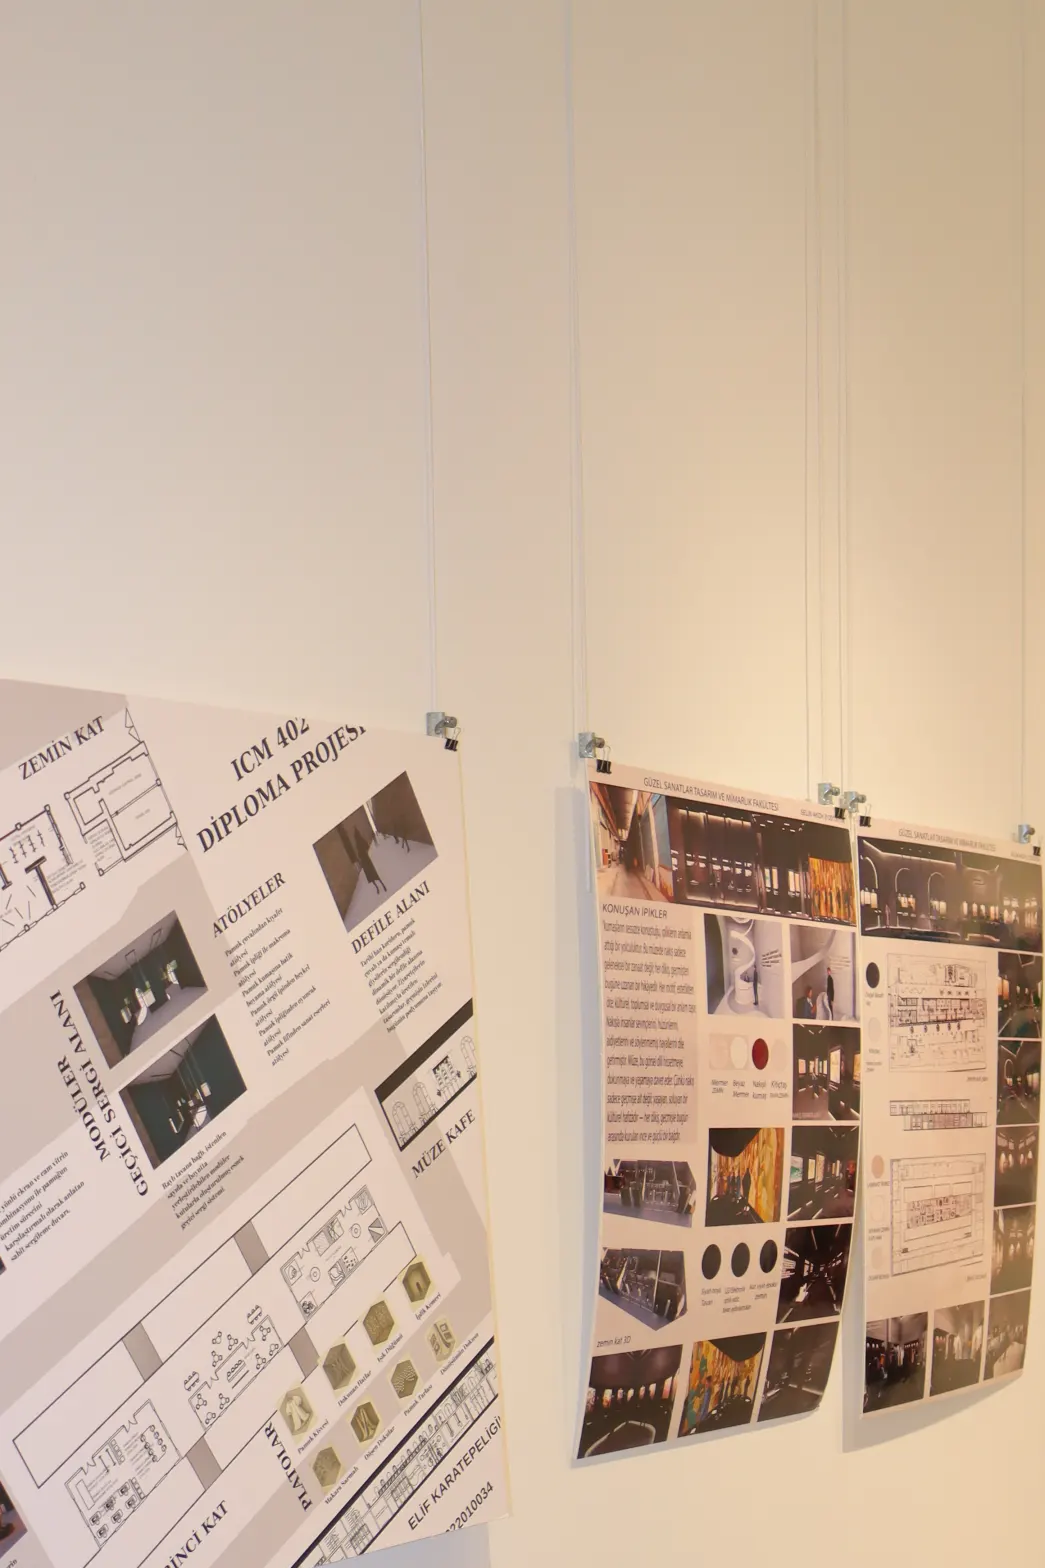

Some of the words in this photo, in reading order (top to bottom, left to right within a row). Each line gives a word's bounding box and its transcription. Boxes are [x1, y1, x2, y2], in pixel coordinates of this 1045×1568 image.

[18, 736, 72, 780] ZEMİN
[74, 716, 104, 746] KAT
[231, 737, 274, 781] ICM
[276, 716, 310, 748] 402
[196, 773, 291, 852] DİPLOMA
[644, 777, 662, 790] GÜZEL
[664, 782, 692, 794] SANATLAR
[694, 787, 717, 799] TASARIM
[213, 872, 285, 938] ATÖLYELER
[351, 911, 394, 954] DEFİLE
[396, 881, 430, 918] ALANI
[603, 904, 640, 917] KONUŞAN
[224, 941, 242, 957] Pamuk
[233, 961, 251, 977] Pamuk
[241, 981, 259, 997] Pamuk
[250, 1001, 268, 1017] Pamuk
[50, 990, 86, 1054] ALANI
[258, 1020, 276, 1037] Pamuk
[267, 1040, 284, 1056] Pamuk
[57, 1056, 110, 1162] MODÜLER
[81, 1059, 116, 1123] SERGİ
[109, 1125, 149, 1196] GEÇİCİ
[412, 1138, 446, 1178] MÜZE
[445, 1109, 475, 1144] KAFE
[17, 1180, 34, 1197] ekran
[40, 1165, 53, 1177] cam
[0, 1194, 35, 1228] ombinasyonu
[33, 1188, 42, 1197] ile
[46, 1198, 64, 1217] olarak
[265, 1421, 313, 1512] PLATOLAR
[408, 1499, 431, 1530] ELİF
[431, 1416, 502, 1503] KARATEPELİGİ
[201, 1500, 228, 1534] KAT
[446, 1482, 494, 1532] 22010034
